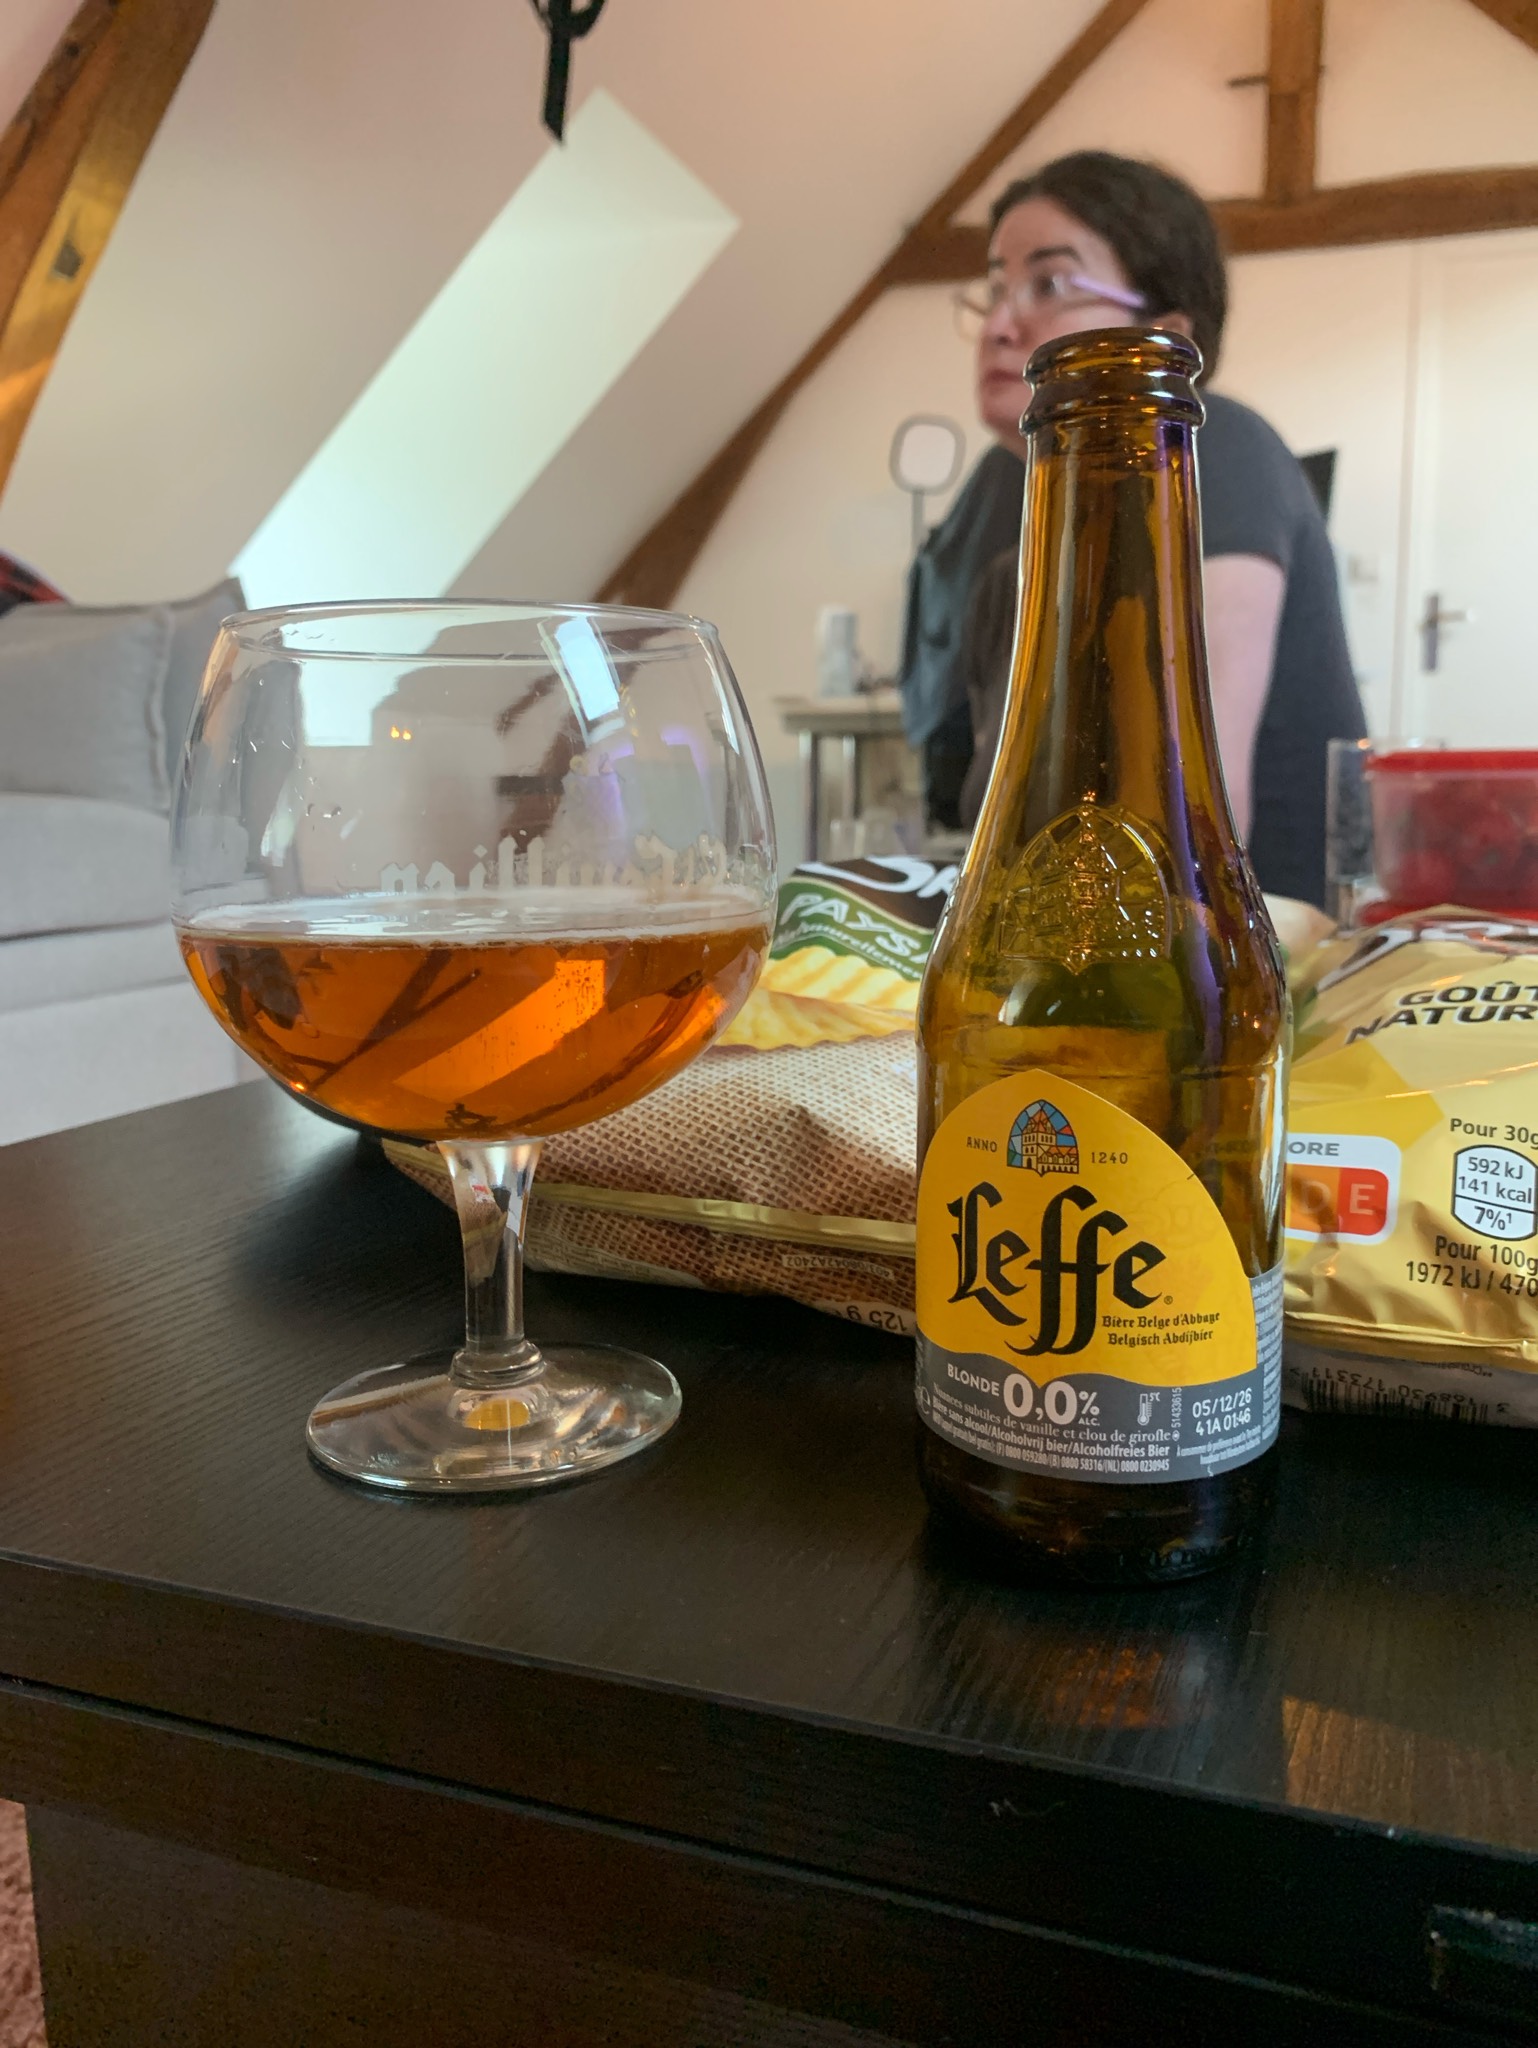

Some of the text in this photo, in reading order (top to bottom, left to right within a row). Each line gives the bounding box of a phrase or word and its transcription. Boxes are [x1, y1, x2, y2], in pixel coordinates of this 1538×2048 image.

[1450, 1117, 1497, 1138] Pour
[966, 1136, 998, 1153] ANNO
[1090, 1152, 1129, 1165] 1240
[1467, 1156, 1524, 1179] 592 kJ
[1349, 1183, 1376, 1215] E
[1458, 1176, 1532, 1204] 141 kcal
[1434, 1235, 1482, 1261] Pour
[946, 1181, 1167, 1357] Leffe
[1406, 1260, 1454, 1287] 1972
[1460, 1265, 1481, 1290] kJ
[1499, 1272, 1538, 1298] 470
[846, 1304, 909, 1332] 125 g
[1101, 1315, 1135, 1328] Bière
[1137, 1315, 1171, 1330] Belge
[1107, 1329, 1214, 1348] Belgisch Abdijbier
[947, 1363, 1000, 1397] BLONDE
[1003, 1373, 1100, 1425] 0,0%
[1171, 1387, 1182, 1428] 51433615
[1192, 1387, 1252, 1418] 05/12/26
[964, 1403, 1001, 1424] subtiles
[1003, 1415, 1017, 1429] de
[1019, 1421, 1060, 1437] vanille
[1062, 1429, 1076, 1439] et
[1078, 1428, 1107, 1442] clou
[1110, 1429, 1126, 1442] de
[1129, 1428, 1171, 1446] girofle
[1078, 1417, 1100, 1426] ALC.
[1147, 1444, 1170, 1458] Bier
